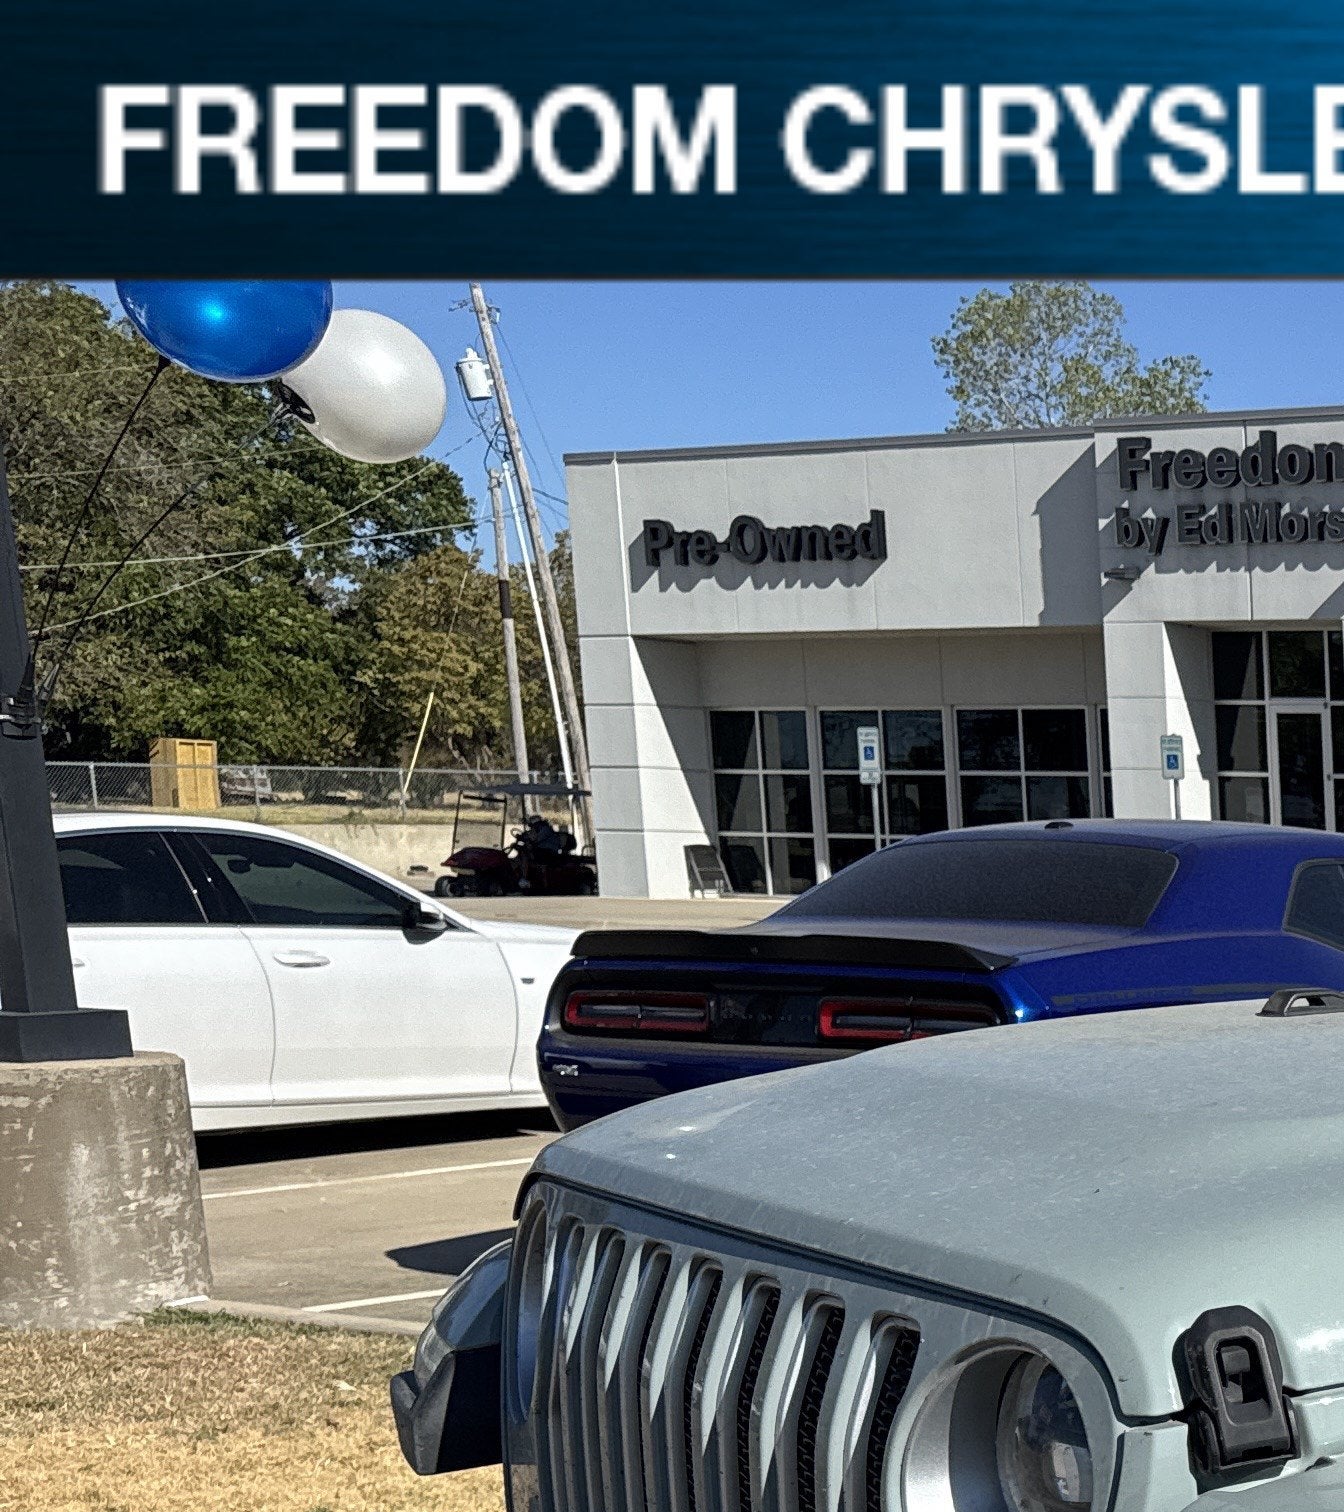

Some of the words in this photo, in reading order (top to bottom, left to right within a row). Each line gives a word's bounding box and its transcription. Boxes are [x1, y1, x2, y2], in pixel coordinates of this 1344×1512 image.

[643, 509, 888, 568] Pre-Owned
[1115, 506, 1170, 556] by
[1177, 502, 1233, 545] Ed
